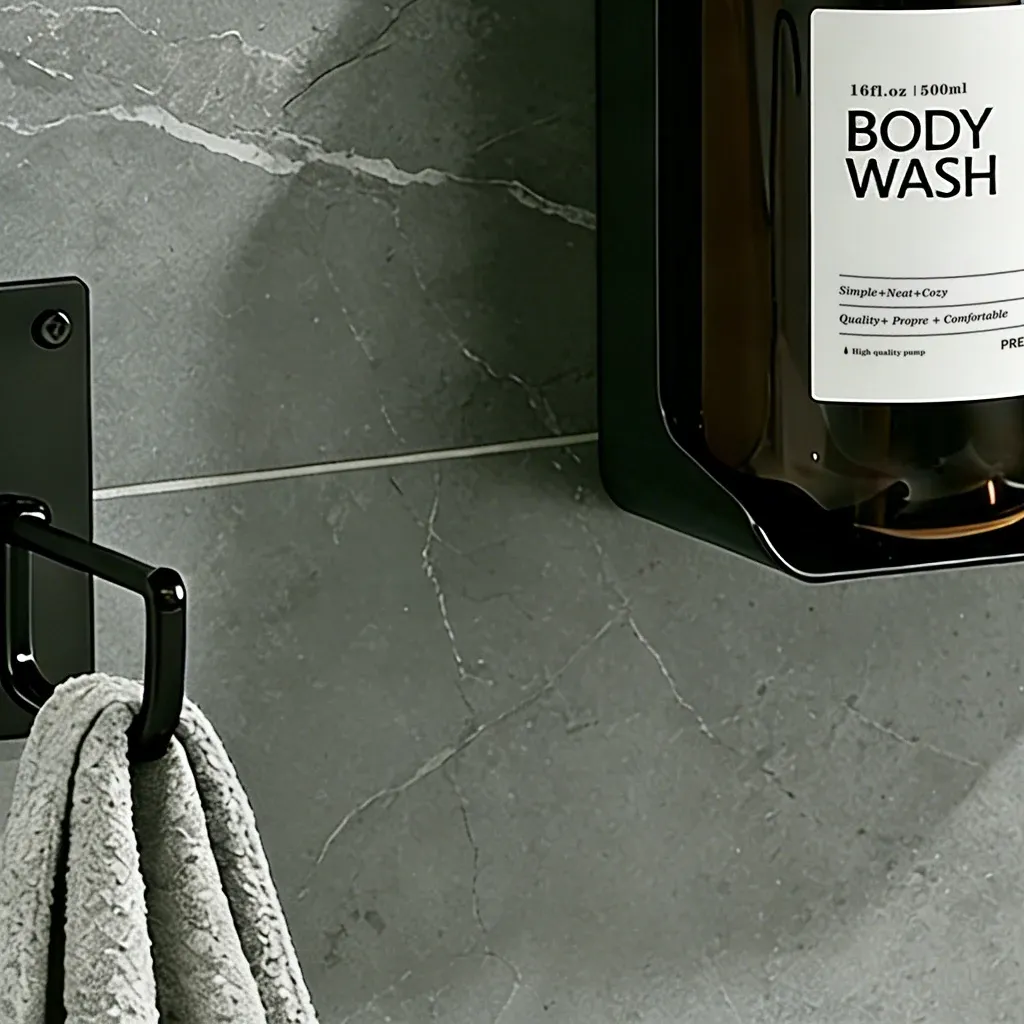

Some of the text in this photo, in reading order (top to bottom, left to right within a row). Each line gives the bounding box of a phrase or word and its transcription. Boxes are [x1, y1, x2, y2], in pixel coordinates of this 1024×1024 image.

[851, 84, 906, 97] 16fl.oz
[921, 82, 967, 96] 500ml
[848, 107, 993, 152] BODY
[845, 155, 996, 198] WASH
[839, 314, 888, 326] Quality+
[892, 316, 929, 327] Propre
[944, 310, 1008, 324] Comfortable
[852, 348, 925, 358] High quality pump
